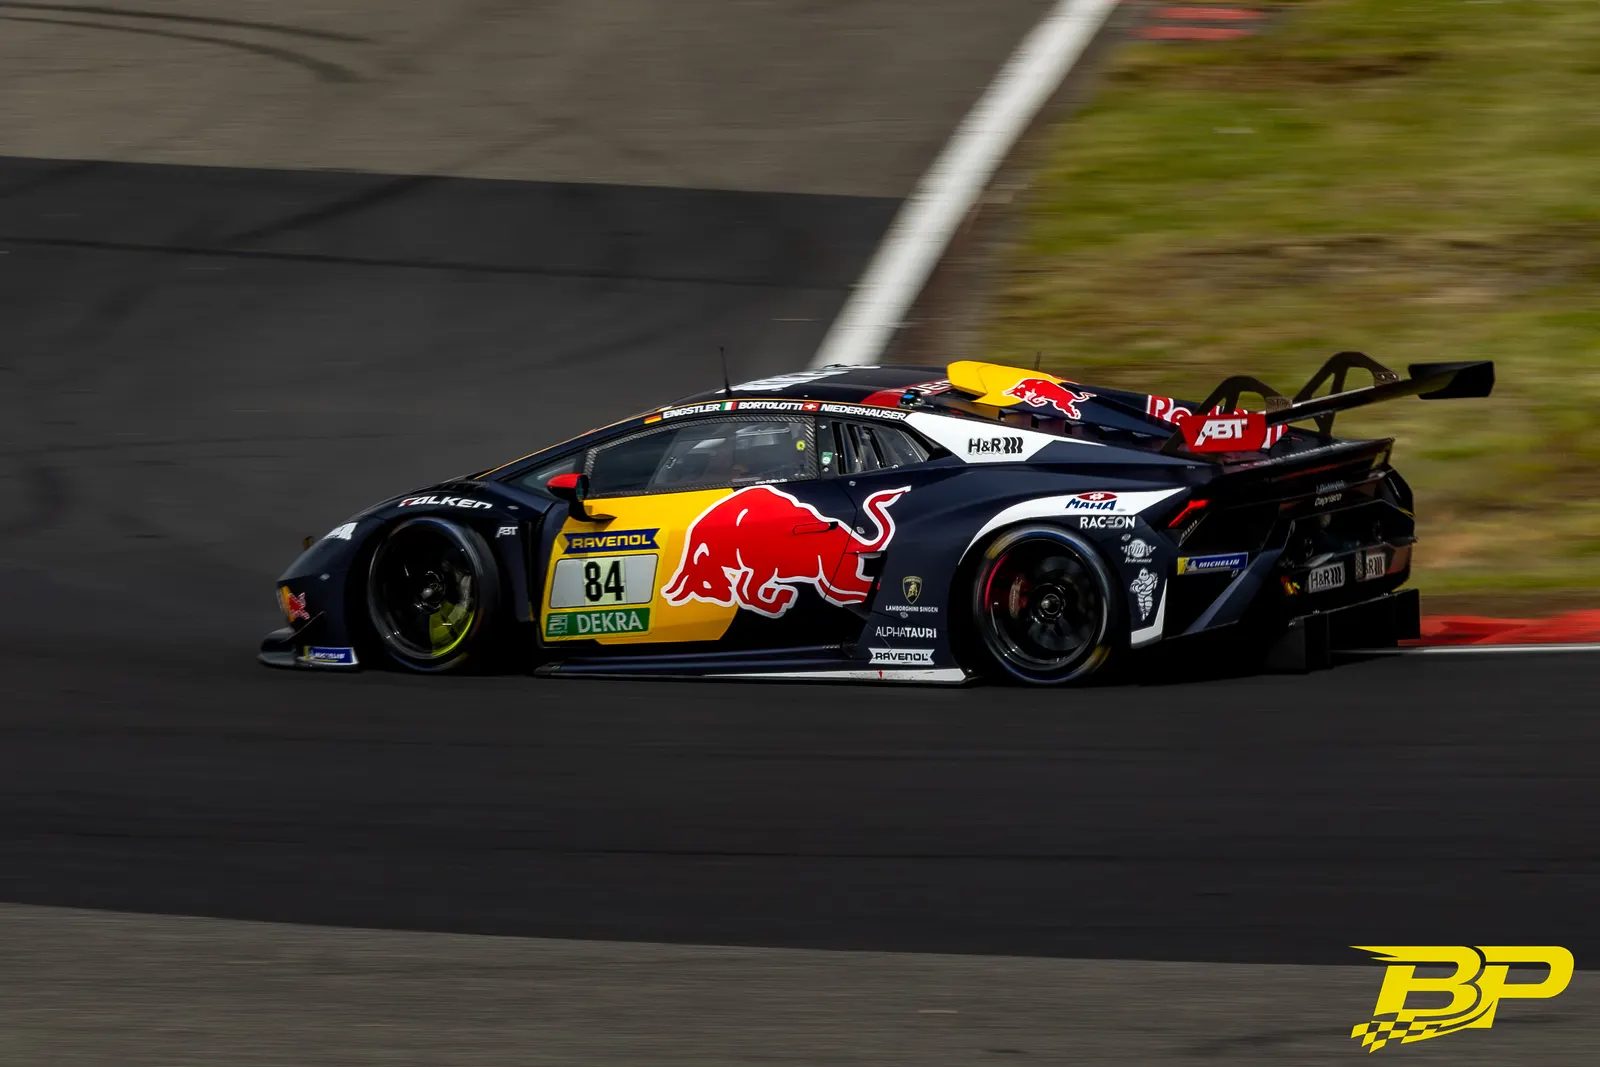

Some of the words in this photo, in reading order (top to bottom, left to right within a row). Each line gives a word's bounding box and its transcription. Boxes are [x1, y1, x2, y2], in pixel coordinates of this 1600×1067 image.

[662, 403, 721, 419] ENGSTLER
[738, 401, 803, 411] BORTOLOTTI
[820, 403, 907, 420] NIEDERHAUSER
[1194, 418, 1248, 447] ABT
[968, 437, 1002, 454] H&R
[398, 495, 494, 509] FALKEN
[1064, 498, 1118, 511] MAHA
[1079, 515, 1136, 529] RACEON
[496, 526, 518, 538] ABT
[571, 534, 652, 549] RAVENOL
[1198, 558, 1241, 568] MICHELIN
[584, 560, 625, 602] 84
[1310, 568, 1331, 589] H&R
[576, 610, 644, 634] DEKRA
[875, 625, 937, 639] ALPHATAURI
[874, 651, 930, 662] RAVENOL
